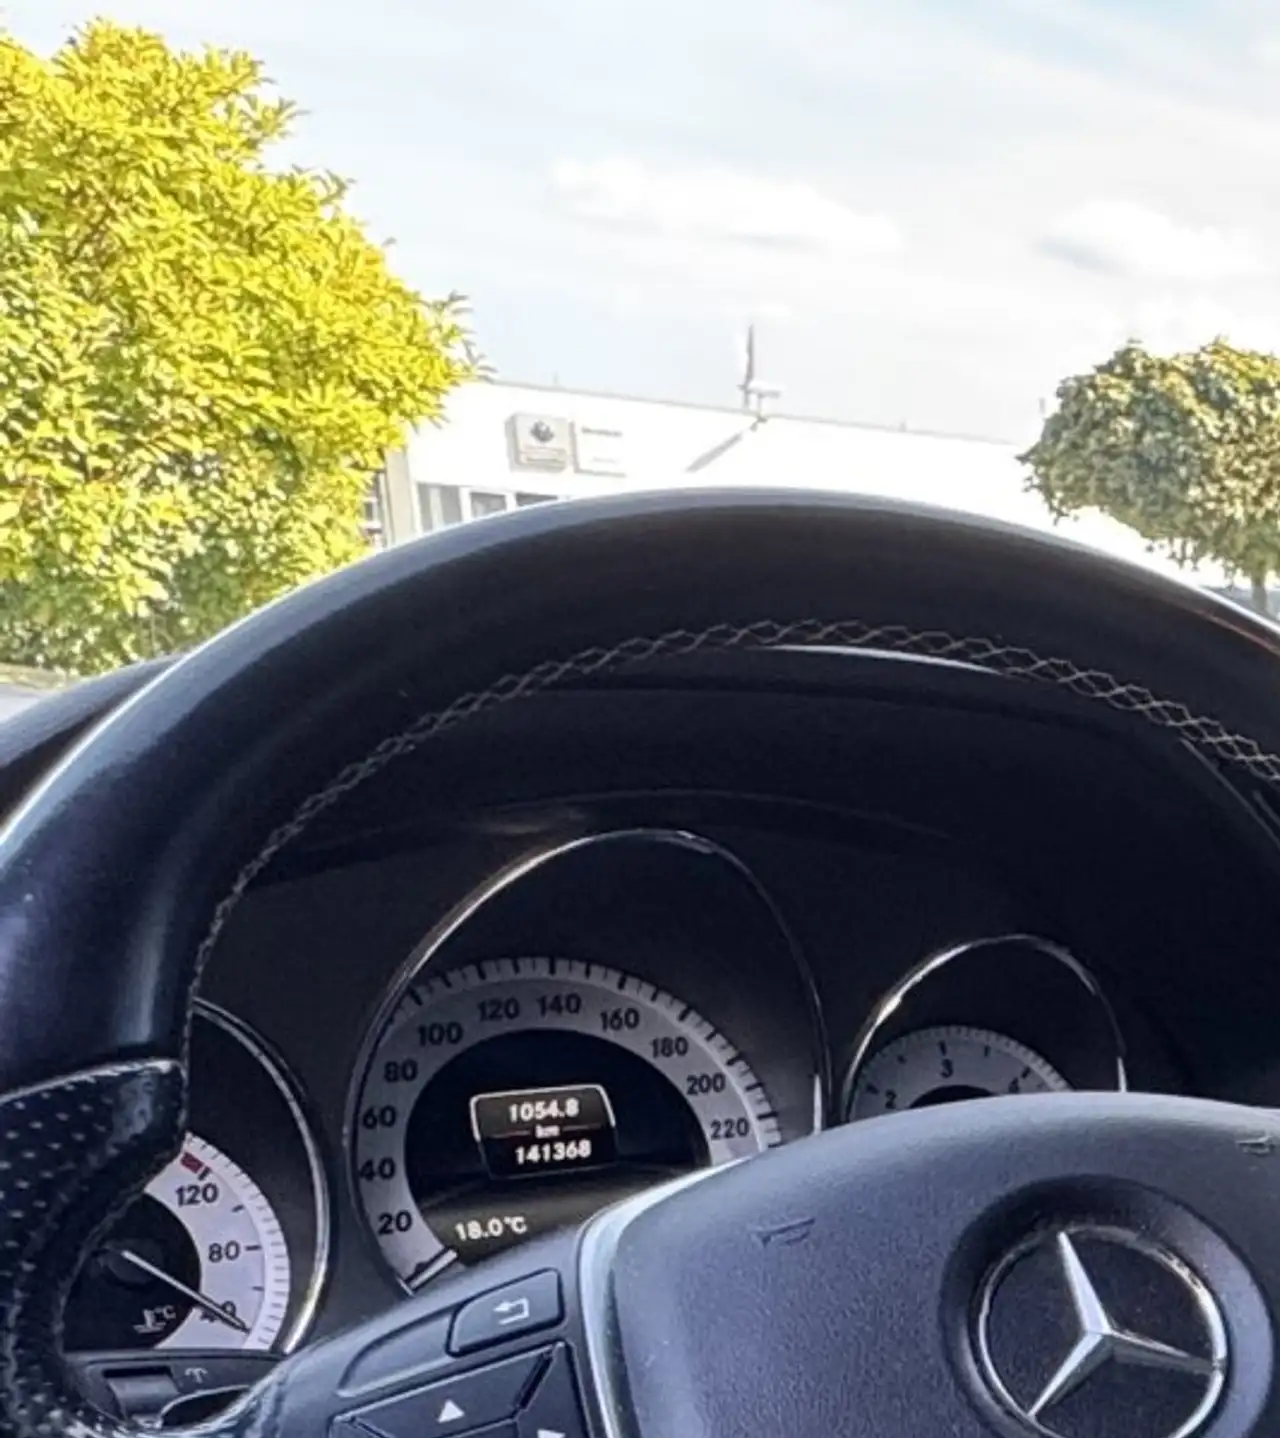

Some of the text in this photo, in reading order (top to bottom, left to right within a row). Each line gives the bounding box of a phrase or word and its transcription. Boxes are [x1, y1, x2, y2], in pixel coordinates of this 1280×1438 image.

[478, 997, 520, 1021] 120
[537, 992, 582, 1017] 140
[600, 1007, 640, 1031] 160
[417, 1022, 464, 1046] 100
[650, 1035, 689, 1059] 180
[383, 1060, 419, 1083] 80
[686, 1072, 726, 1097] 200
[363, 1108, 396, 1130] 60
[508, 1098, 580, 1122] 1054.8
[710, 1117, 750, 1141] 220
[515, 1139, 592, 1165] 141368
[359, 1158, 396, 1181] 40
[175, 1182, 219, 1207] 120
[377, 1213, 413, 1236] 20
[208, 1240, 241, 1263] 80
